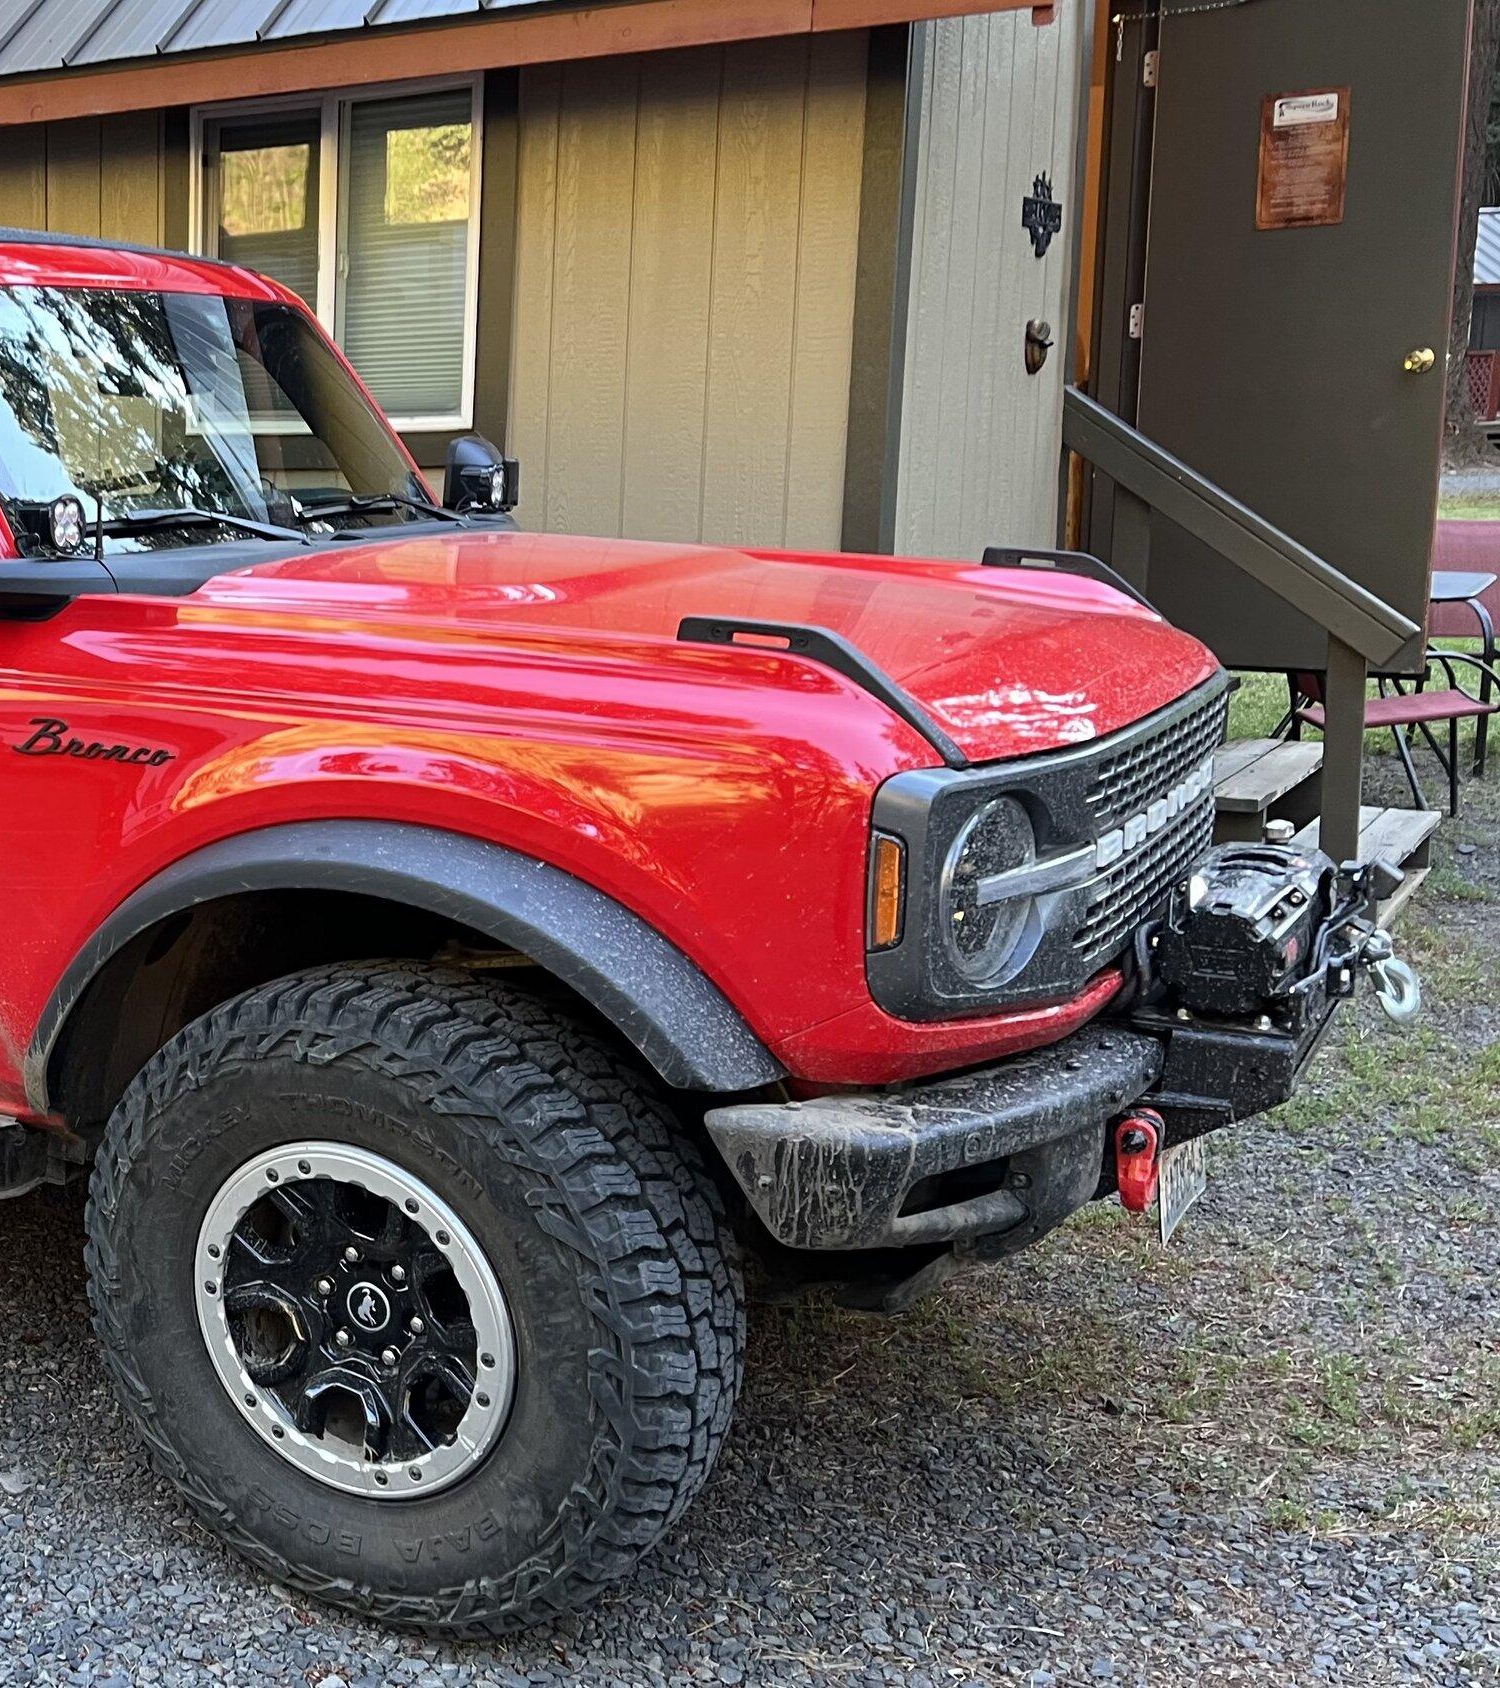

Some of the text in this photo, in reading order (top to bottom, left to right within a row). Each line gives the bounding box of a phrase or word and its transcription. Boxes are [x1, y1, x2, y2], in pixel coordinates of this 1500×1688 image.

[12, 717, 176, 767] Bronco
[246, 1486, 506, 1565] BAJA BOSS
